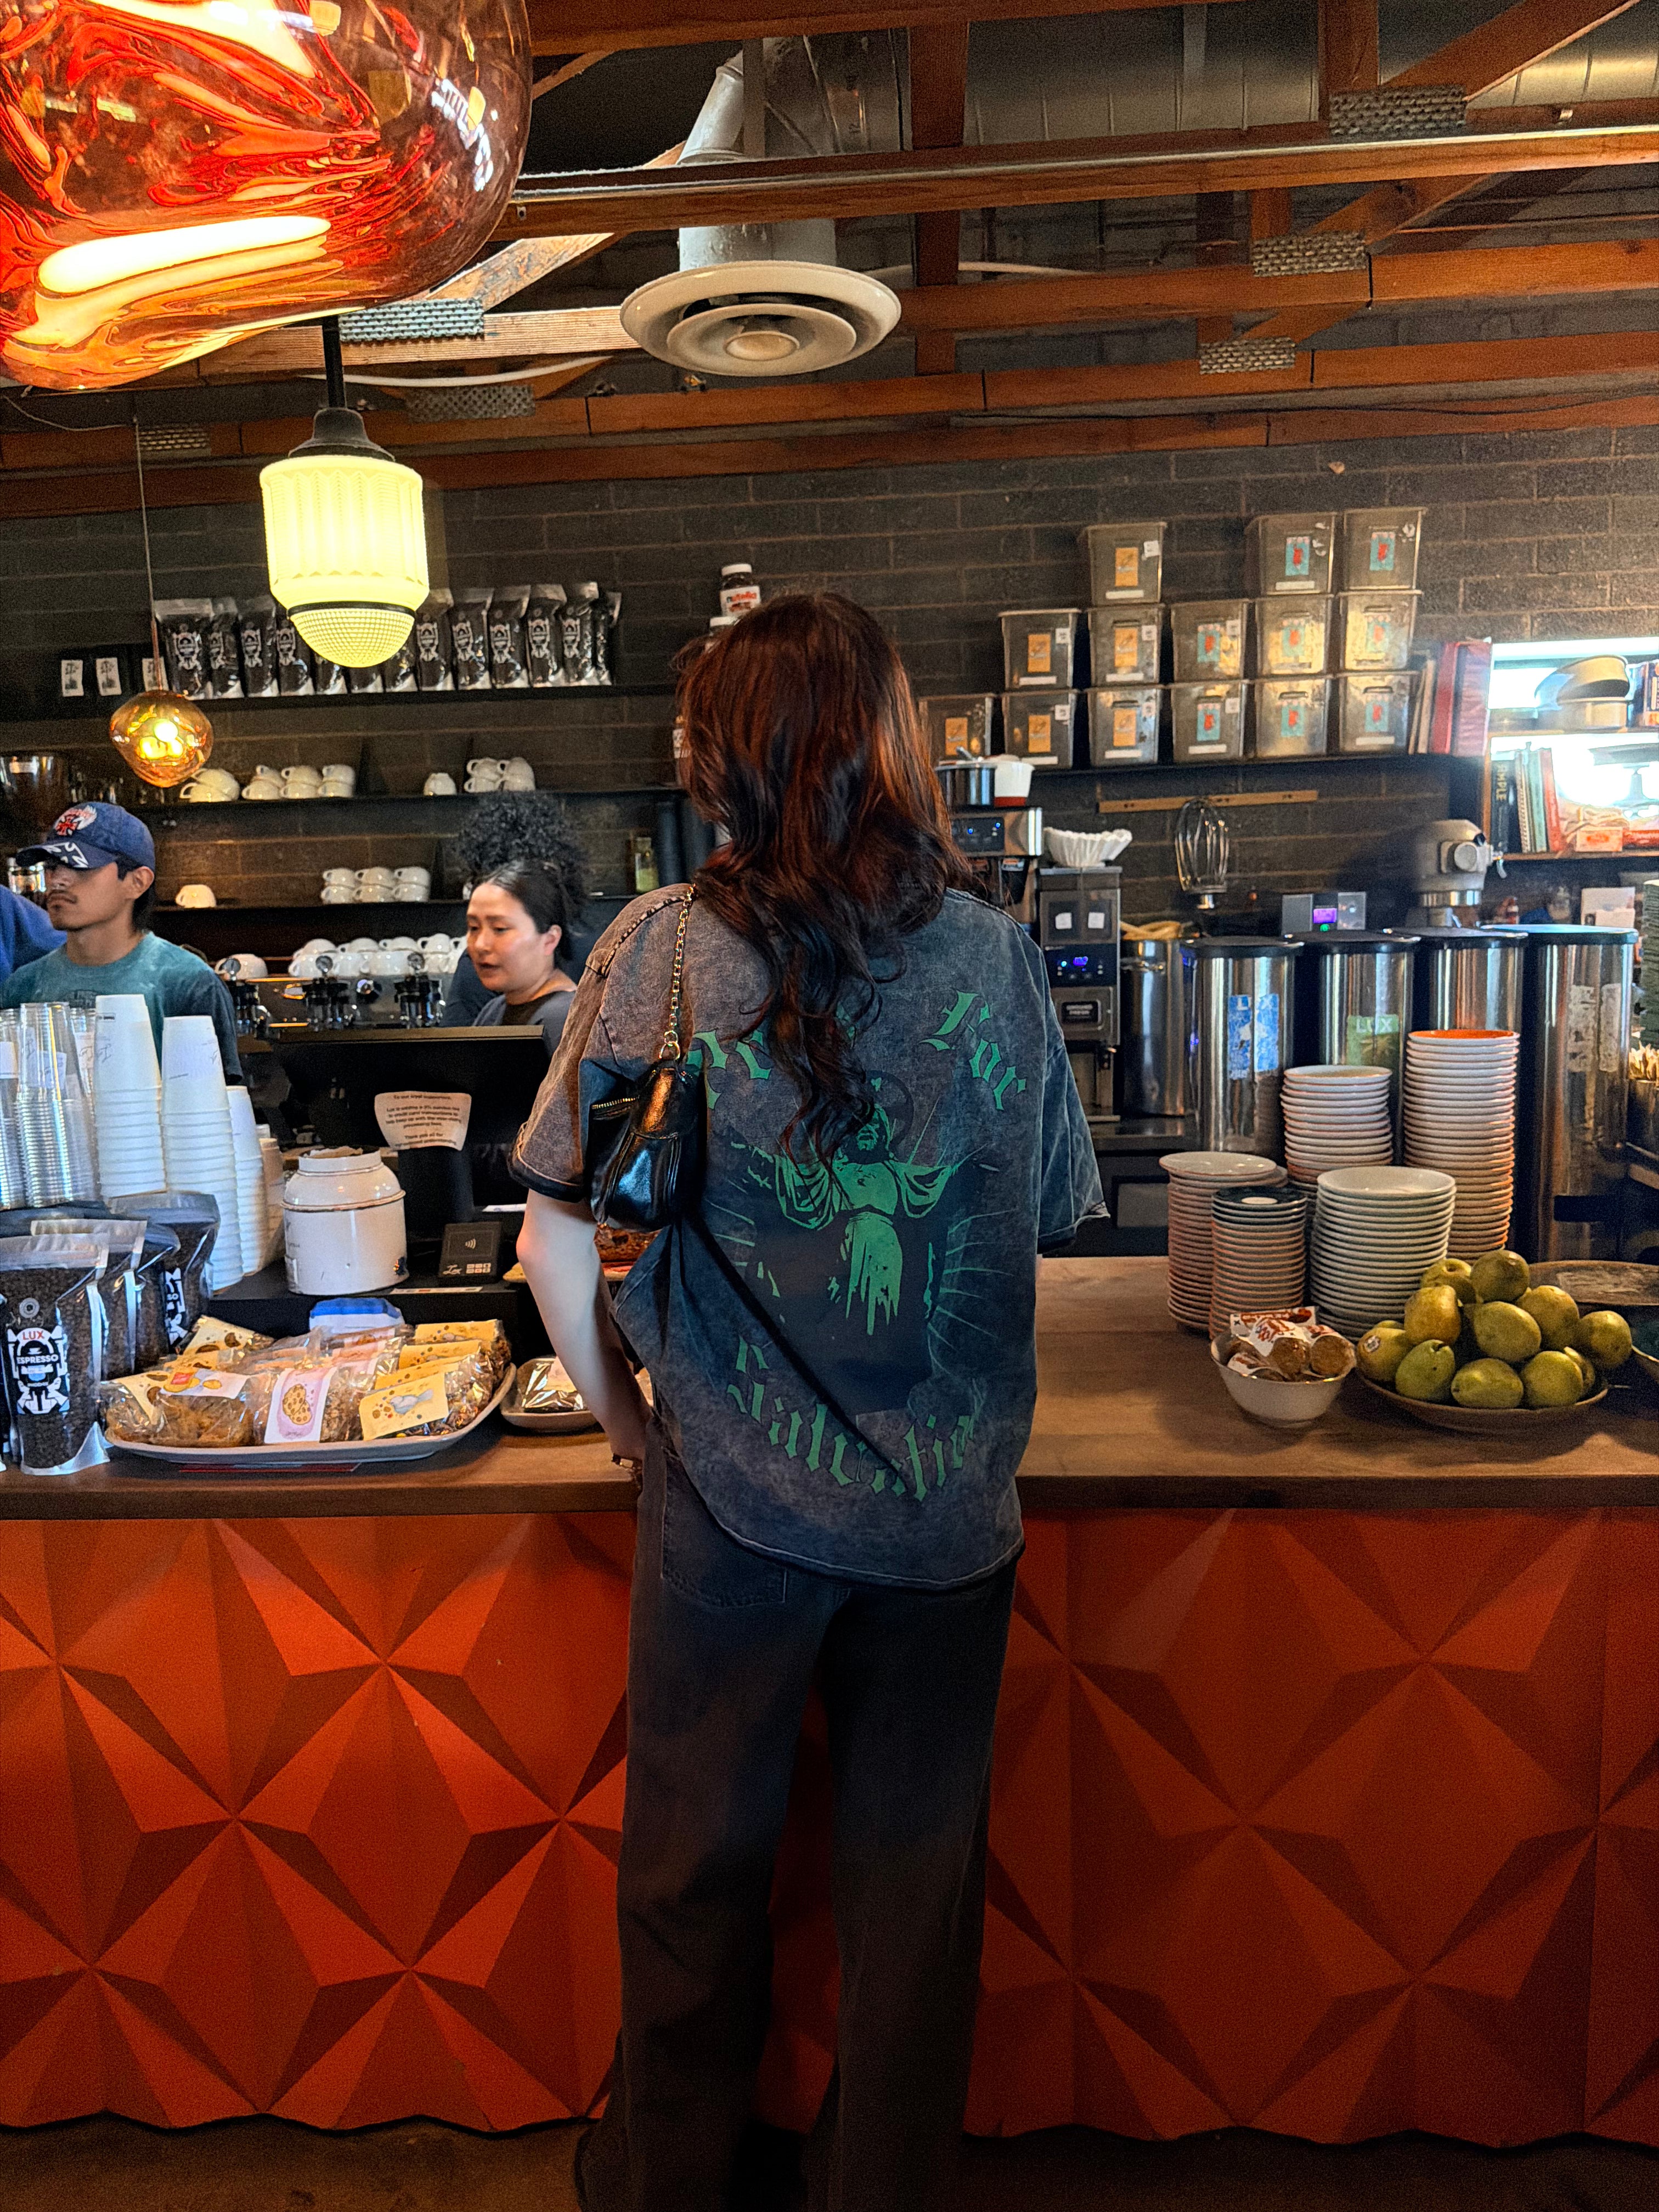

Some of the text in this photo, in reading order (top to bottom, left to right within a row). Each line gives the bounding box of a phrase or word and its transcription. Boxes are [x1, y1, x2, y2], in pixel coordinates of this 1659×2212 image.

[1237, 994, 1274, 1011] LX
[22, 1330, 45, 1340] LUX
[16, 1354, 59, 1364] ESPRESSO
